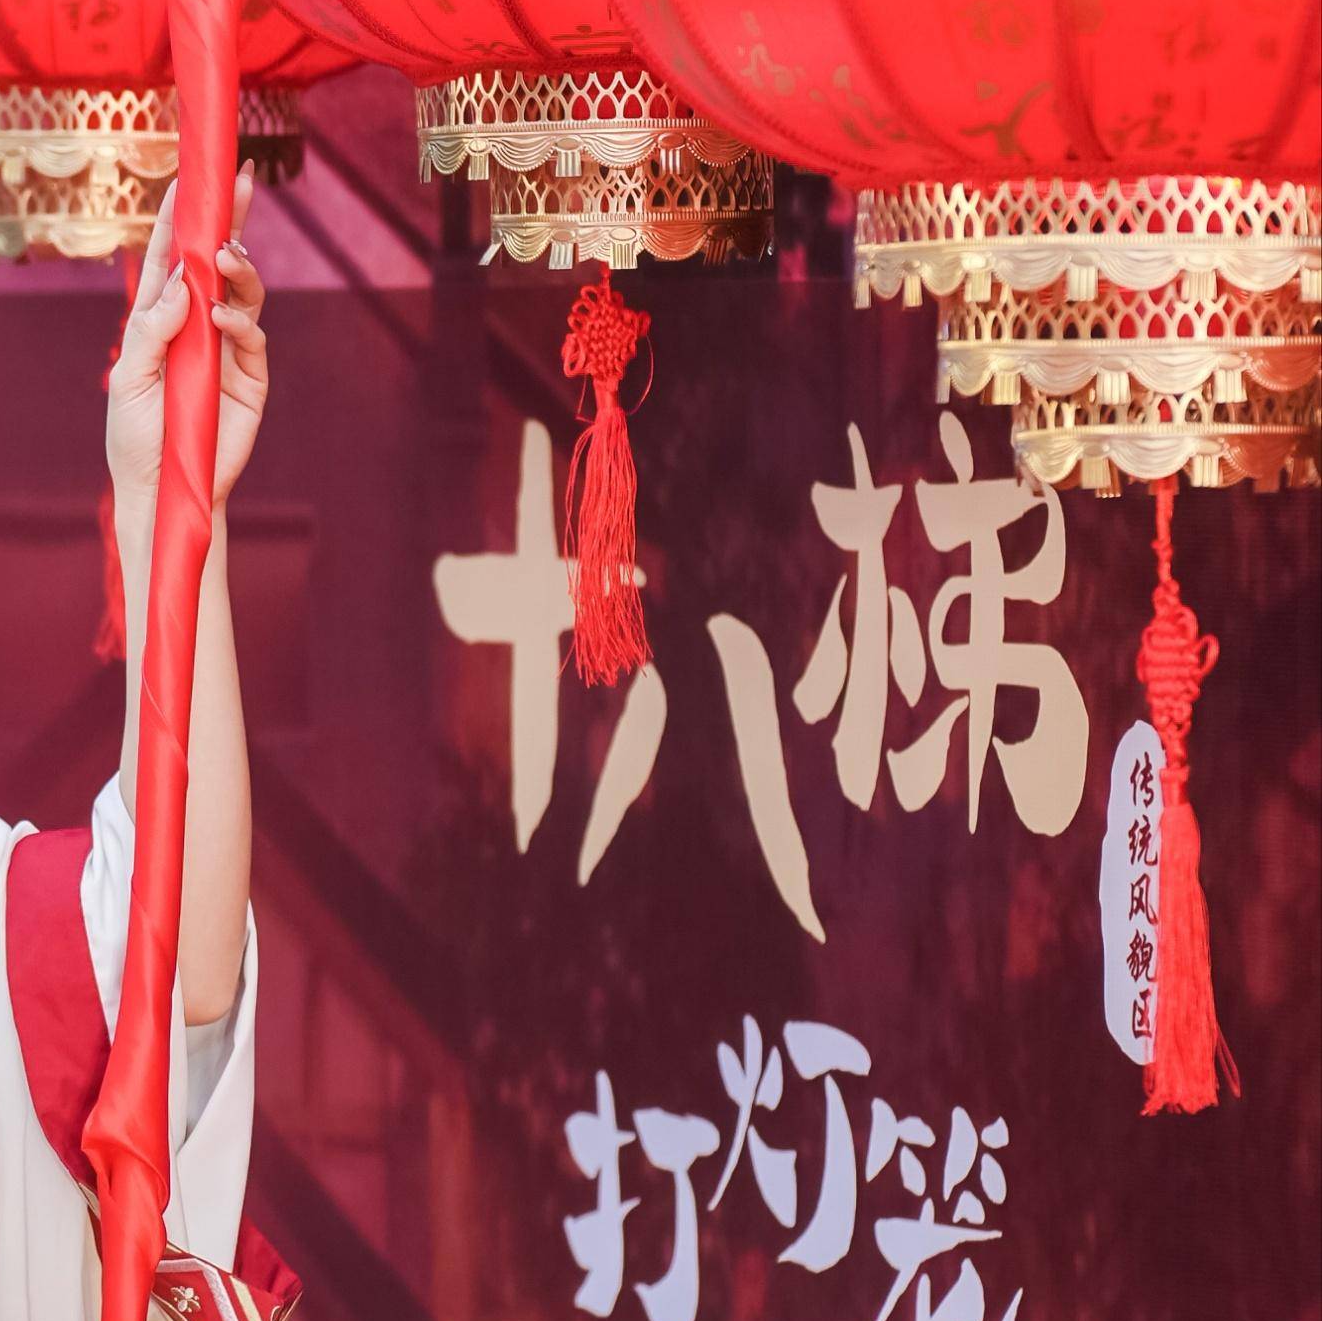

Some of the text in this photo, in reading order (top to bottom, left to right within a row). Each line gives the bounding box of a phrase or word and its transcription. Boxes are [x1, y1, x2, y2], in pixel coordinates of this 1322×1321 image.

[433, 411, 1090, 945] 十八梯
[1127, 751, 1158, 1039] 传统风貌区
